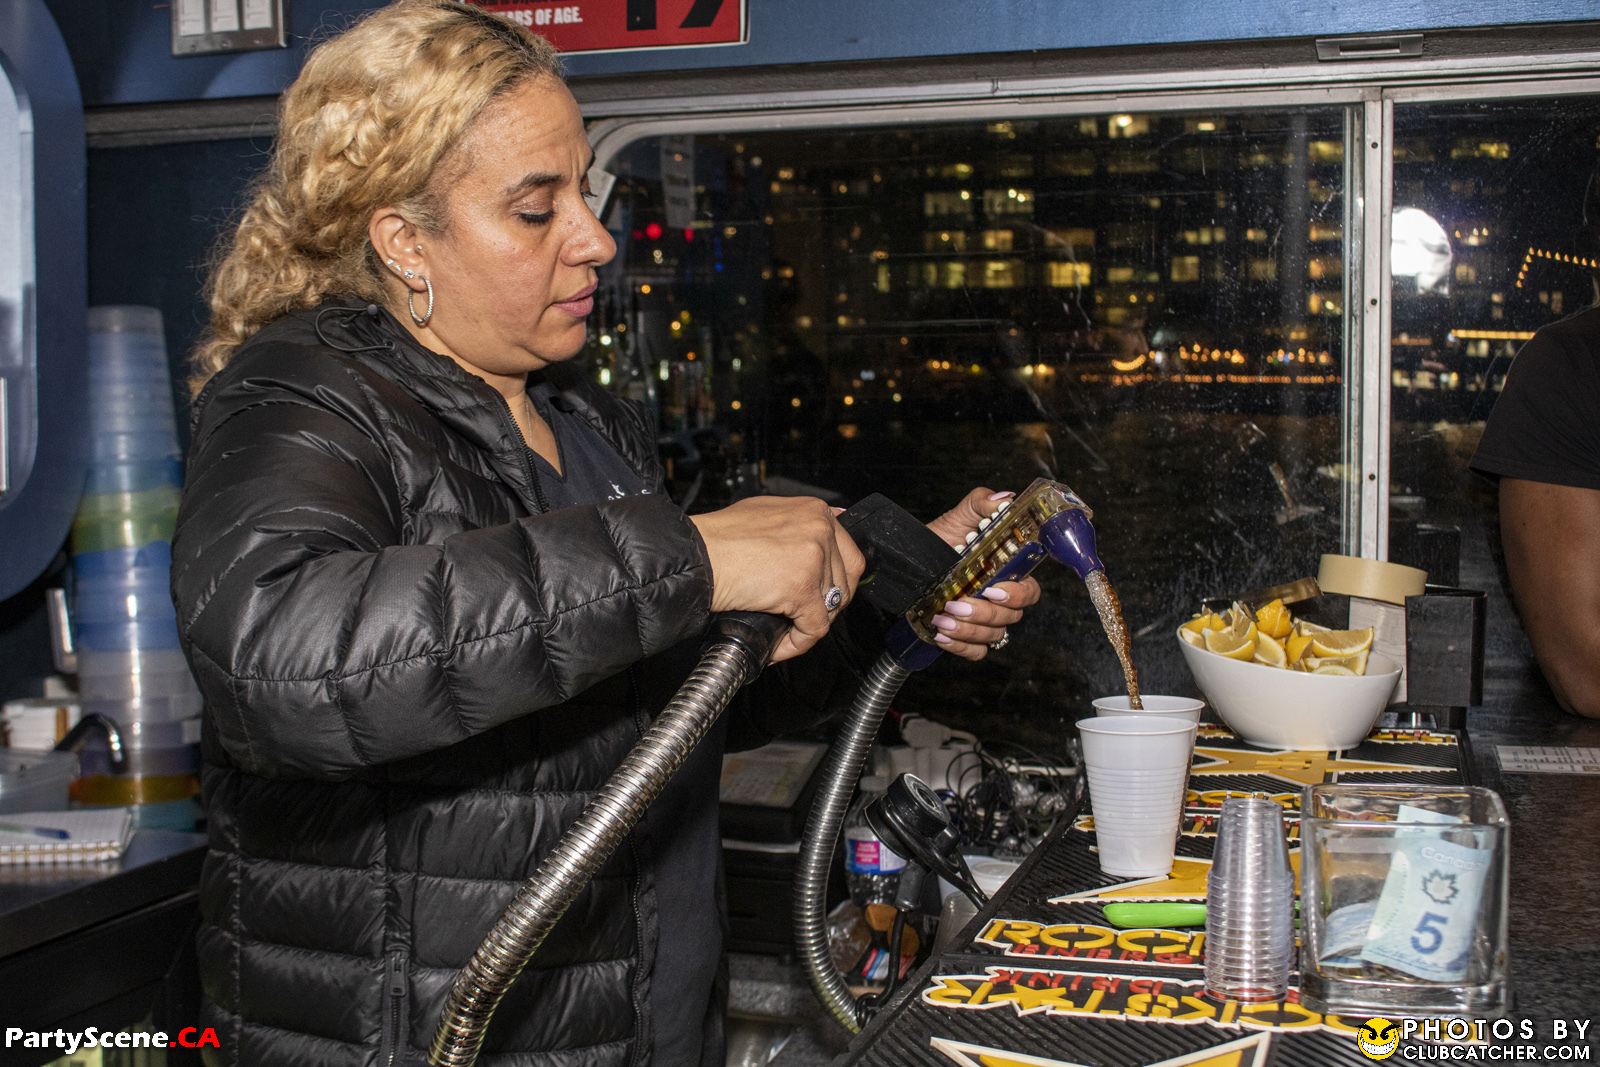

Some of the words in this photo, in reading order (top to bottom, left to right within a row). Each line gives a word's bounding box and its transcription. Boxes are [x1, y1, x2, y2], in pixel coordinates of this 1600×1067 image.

[535, 8, 552, 25] OF
[553, 6, 583, 24] AGE.
[1410, 911, 1448, 955] 5
